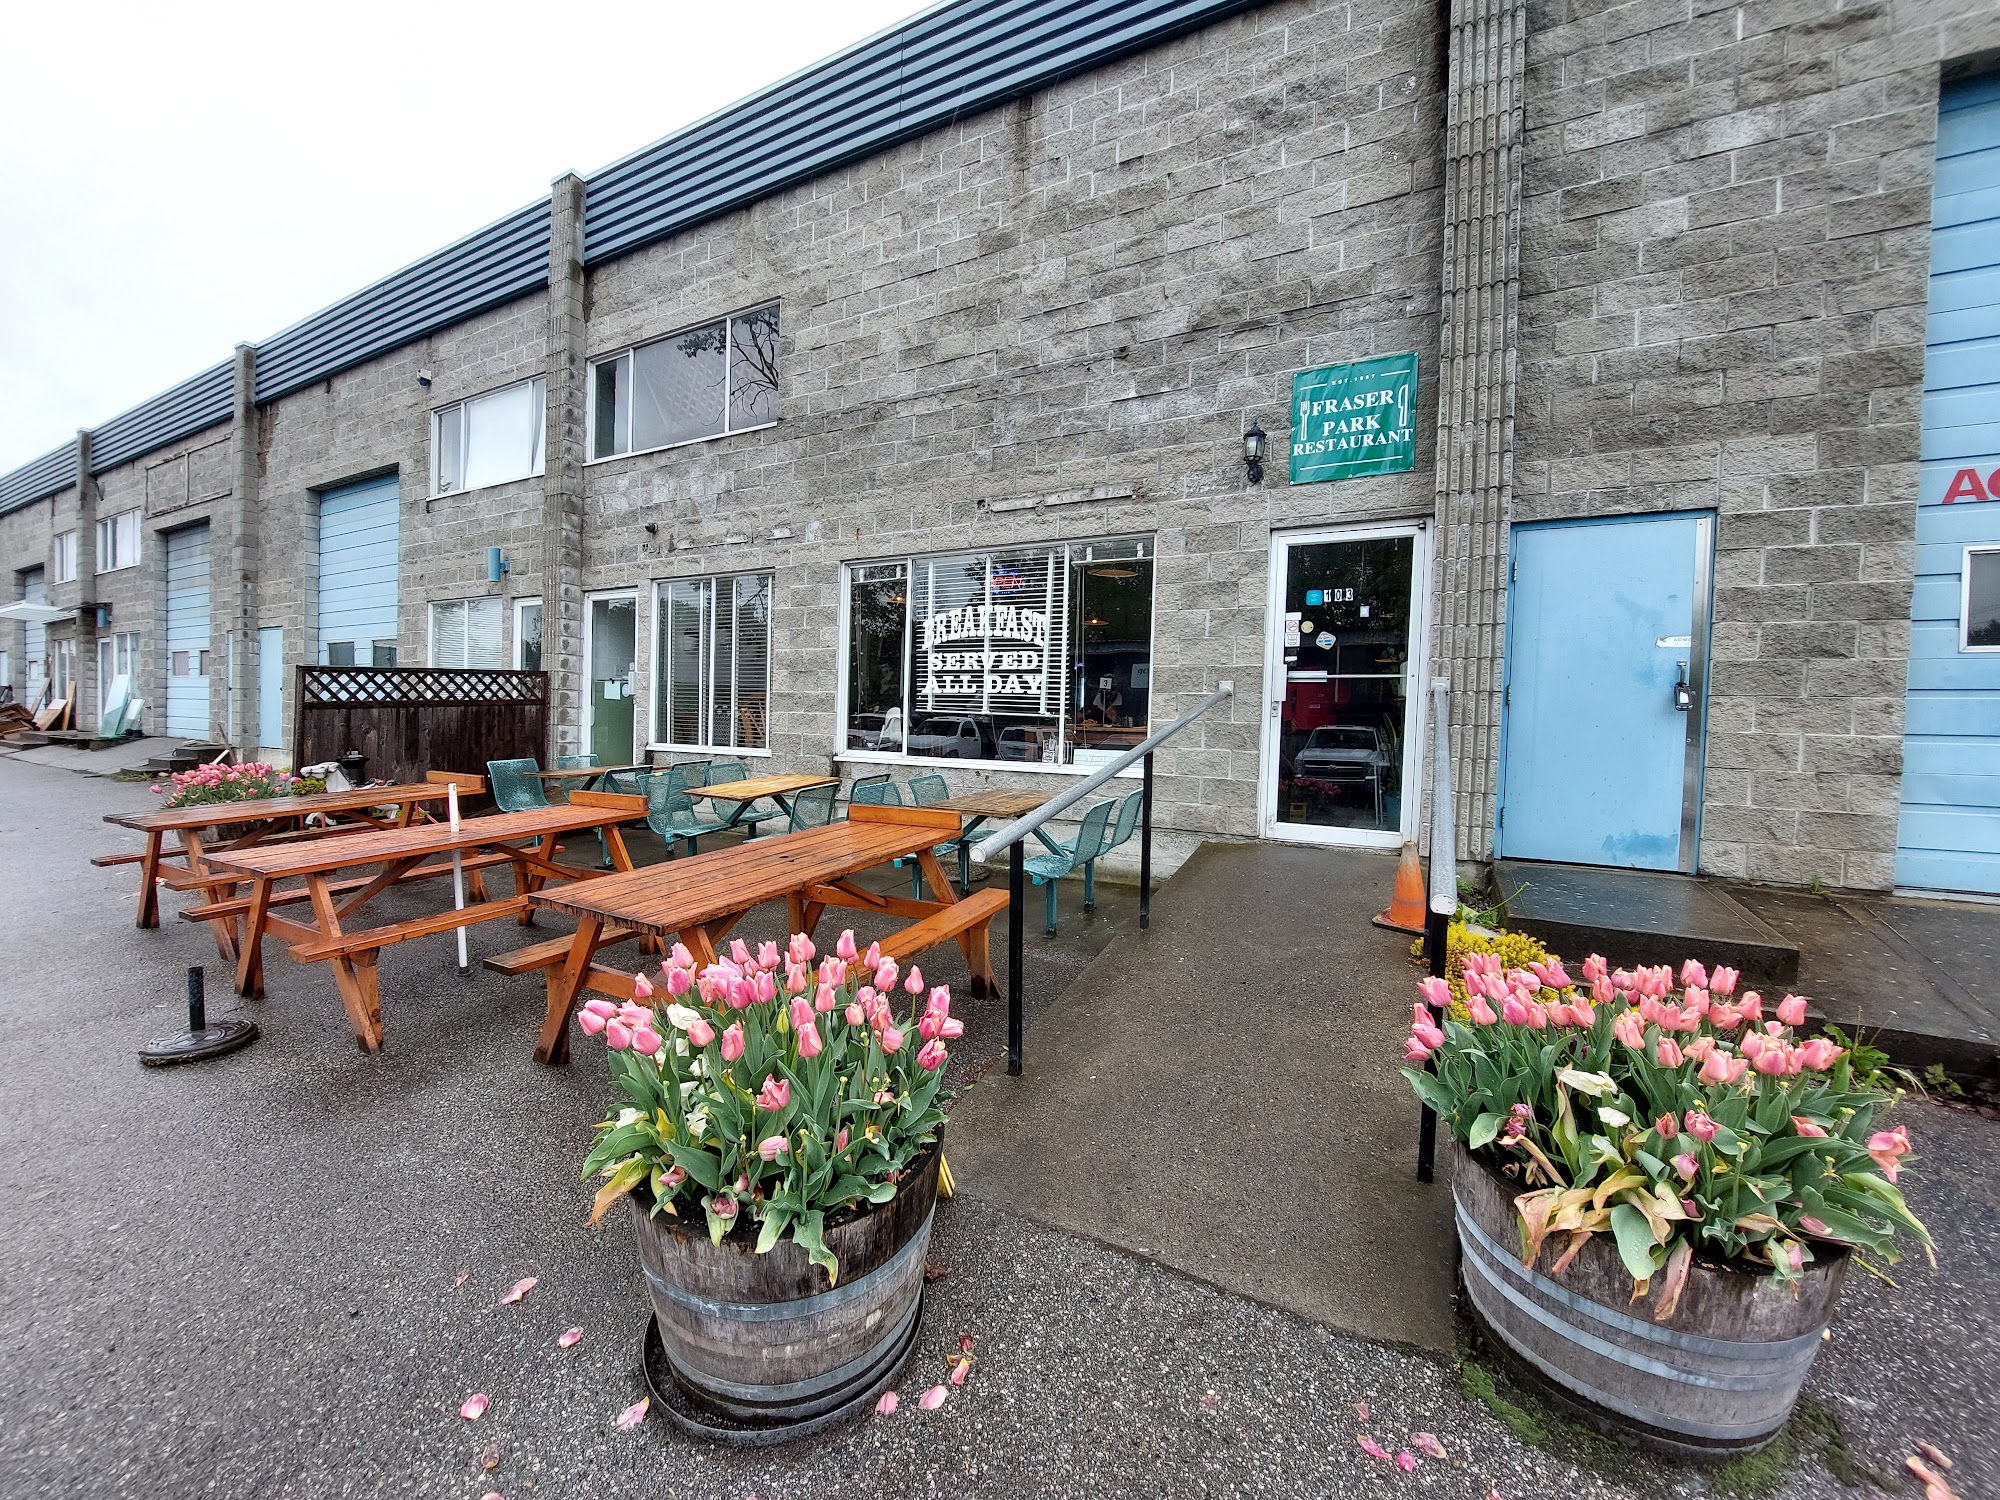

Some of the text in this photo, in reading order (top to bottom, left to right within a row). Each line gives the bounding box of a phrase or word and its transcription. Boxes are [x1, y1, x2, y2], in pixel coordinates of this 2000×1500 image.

[1311, 389, 1395, 416] FRASER
[1322, 413, 1381, 437] PARK
[1292, 428, 1414, 457] RESTAURANT
[1325, 588, 1353, 602] 103
[922, 605, 1046, 650] BREAKFAST
[930, 651, 1039, 671] SERVED
[920, 674, 1042, 694] ALL DAY
